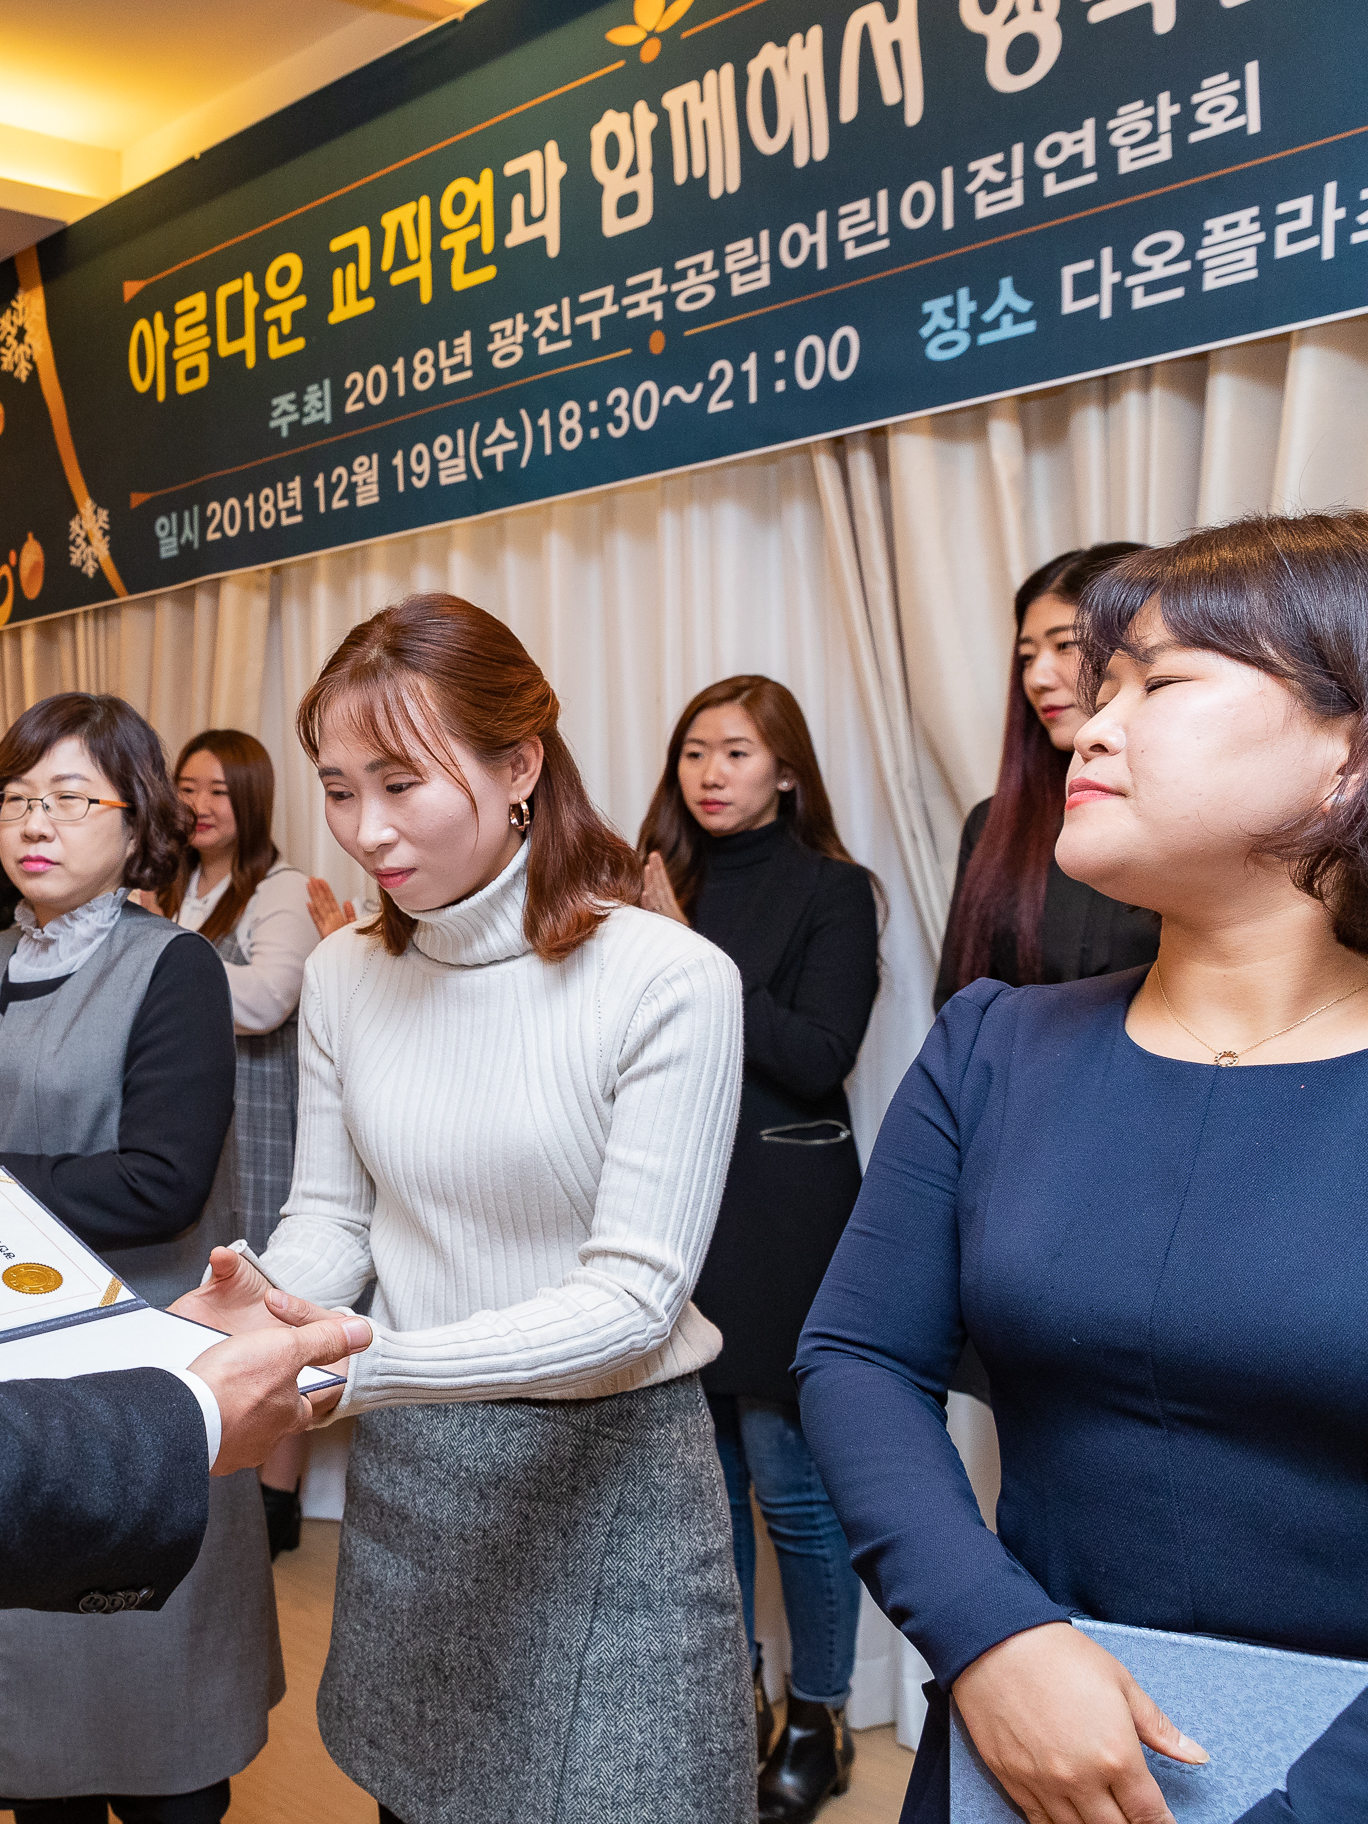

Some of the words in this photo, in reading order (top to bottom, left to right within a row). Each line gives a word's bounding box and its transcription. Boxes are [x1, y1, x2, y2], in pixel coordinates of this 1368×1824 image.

[129, 252, 307, 402] 아름다운
[328, 139, 567, 324] 교직원과
[590, 0, 924, 237] 함께해서
[269, 379, 332, 437] 주최
[344, 330, 473, 414] 2018년
[487, 59, 1262, 369] 광진구국공립어린이집연합회
[154, 505, 199, 560] 일시
[206, 475, 303, 542] 2018년
[314, 453, 380, 513] 12월
[918, 276, 1037, 362] 장소
